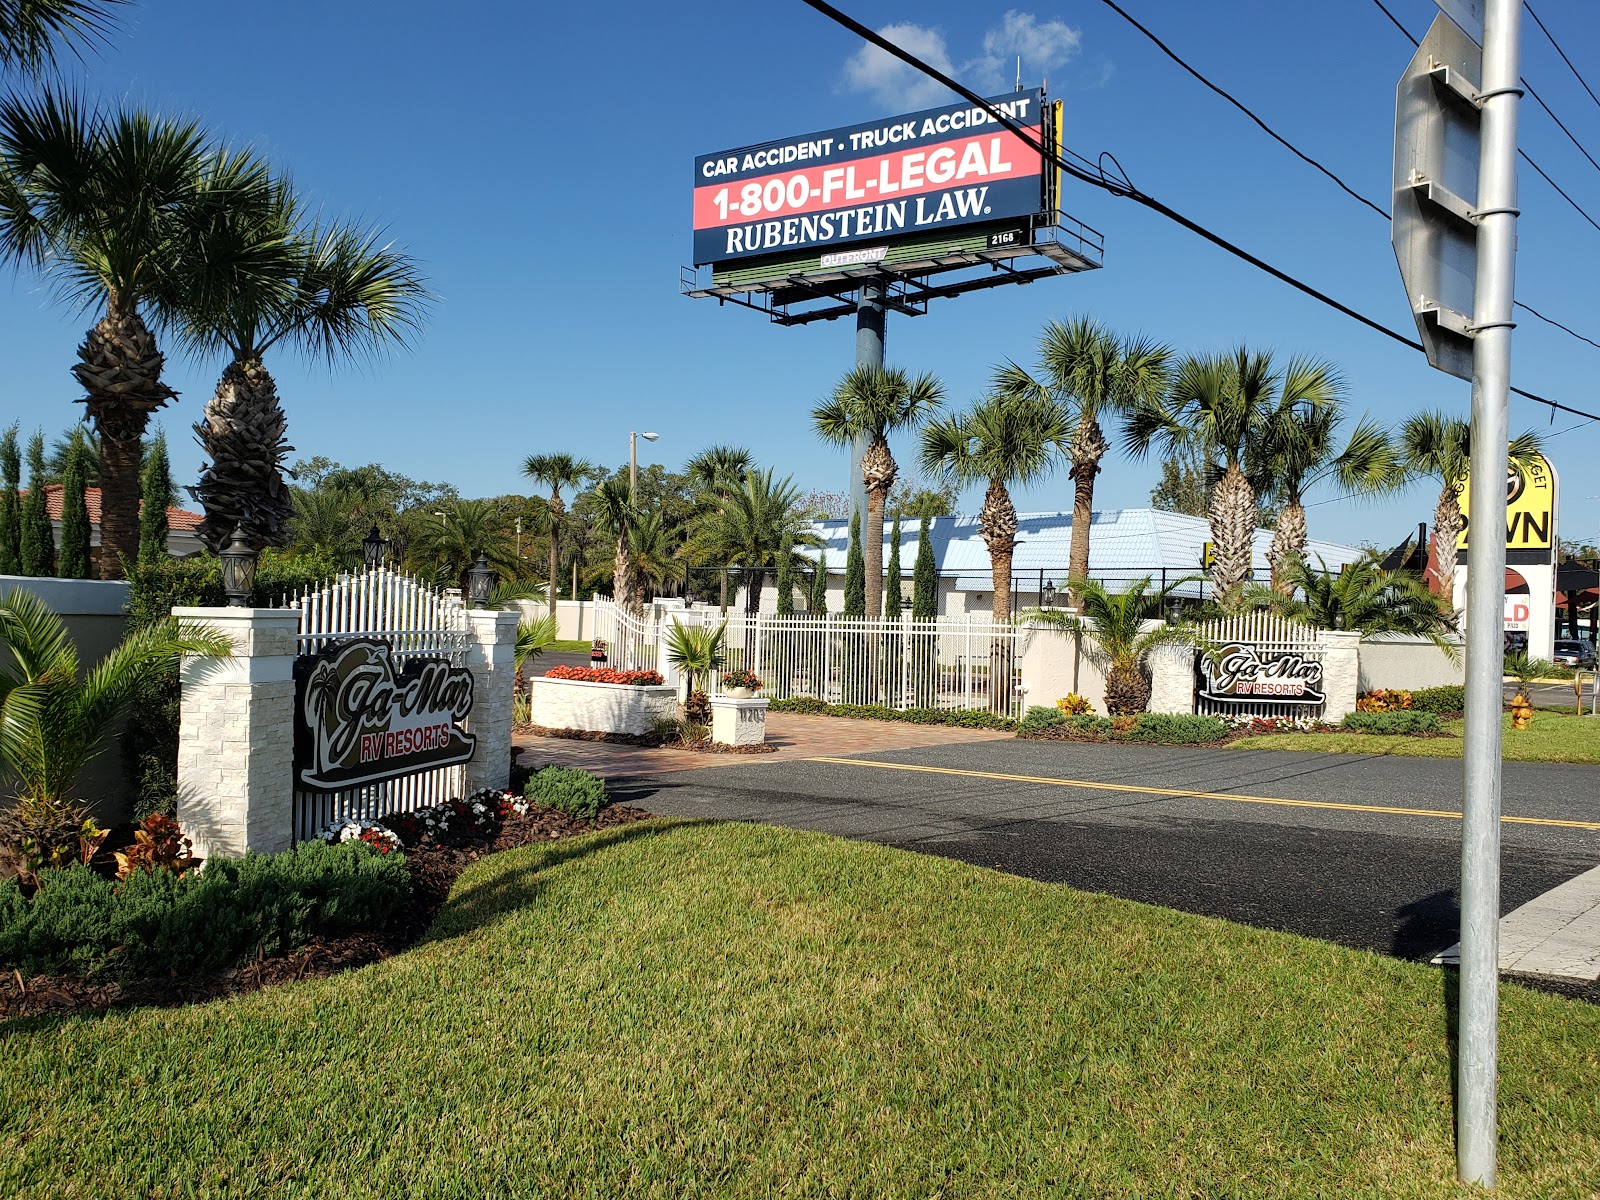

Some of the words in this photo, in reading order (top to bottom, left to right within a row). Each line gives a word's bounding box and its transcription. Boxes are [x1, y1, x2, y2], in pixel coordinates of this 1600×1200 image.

[702, 156, 738, 178] CAR
[741, 138, 833, 171] ACCIDENT
[849, 121, 917, 151] TRUCK
[920, 98, 1030, 137] ACCIDENT
[713, 137, 1012, 220] 1-800-FL-LEGAL
[725, 200, 908, 254] RUBENSTEIN
[991, 233, 1014, 245] 2168
[823, 249, 883, 266] OUTFRONT
[1236, 682, 1253, 695] RV
[1253, 683, 1304, 696] RESORTS
[360, 731, 385, 763] RV
[385, 722, 451, 759] RESORTS
